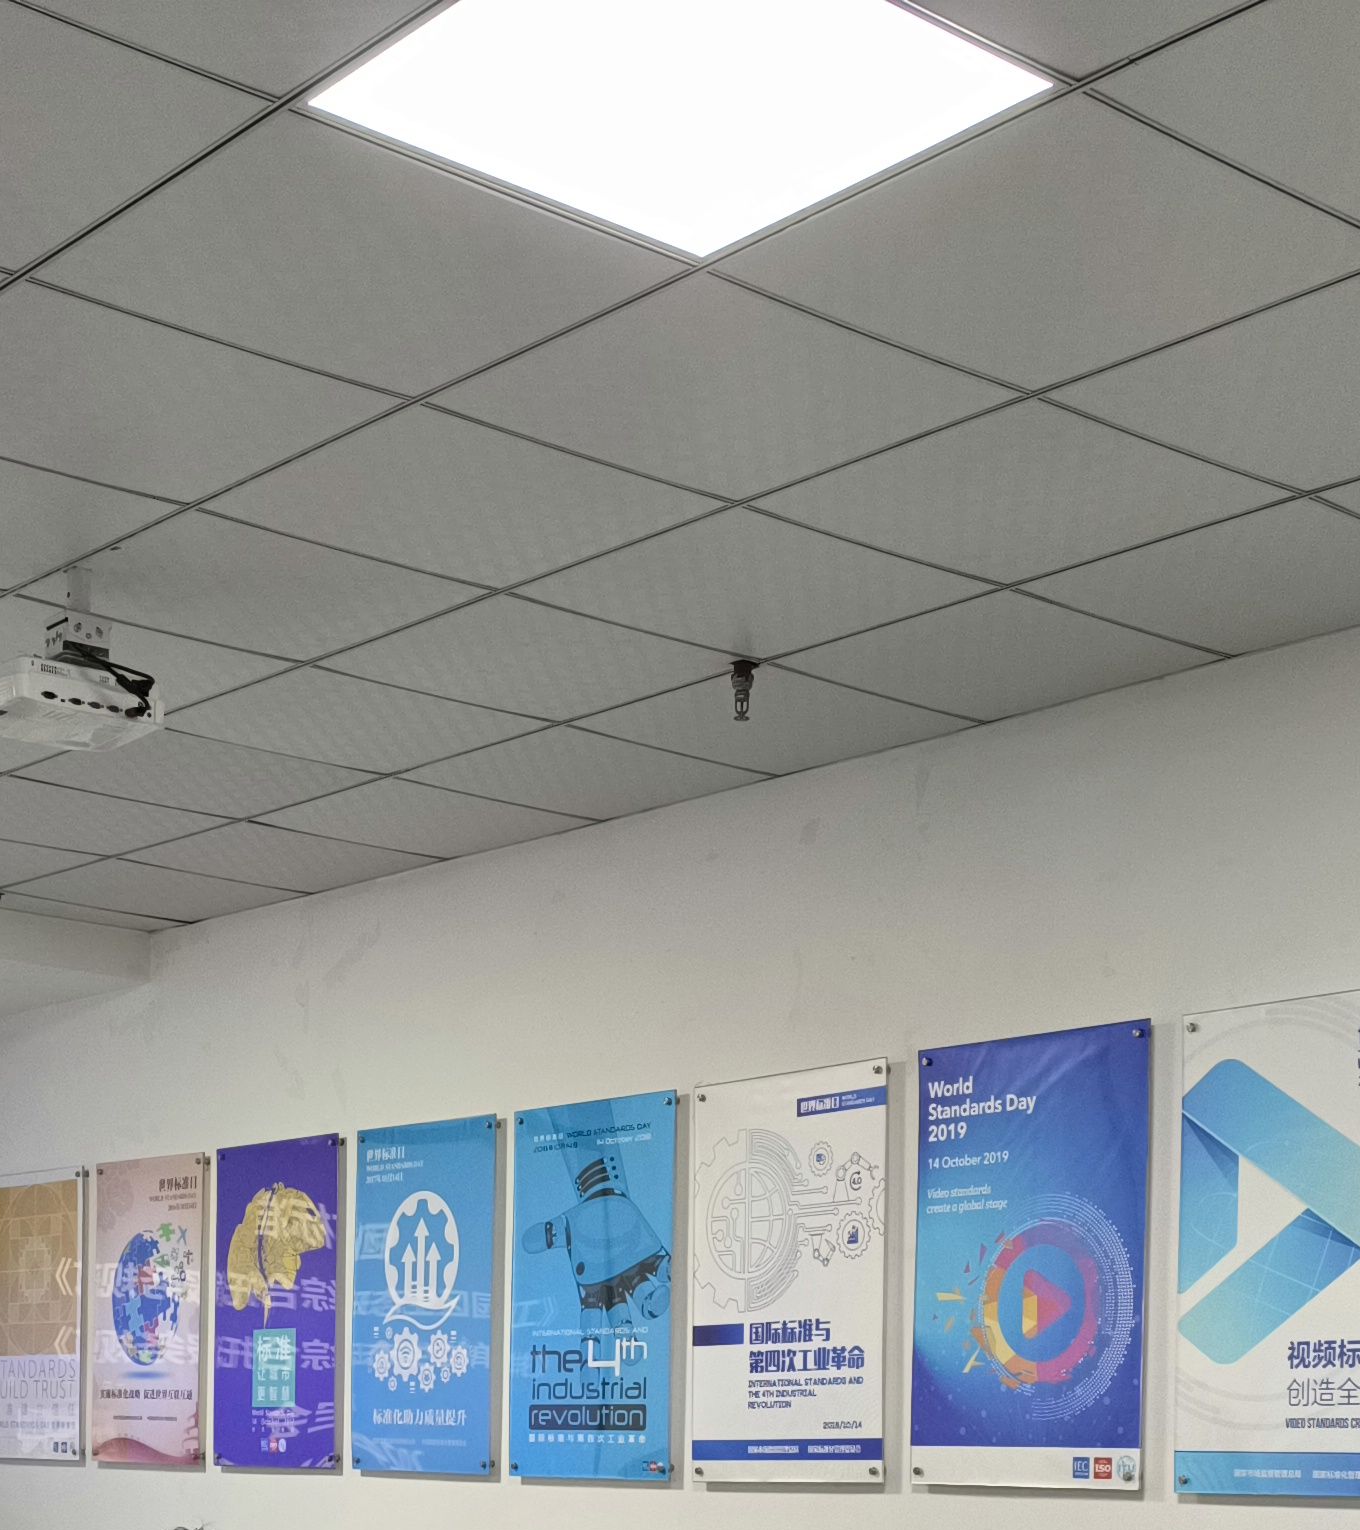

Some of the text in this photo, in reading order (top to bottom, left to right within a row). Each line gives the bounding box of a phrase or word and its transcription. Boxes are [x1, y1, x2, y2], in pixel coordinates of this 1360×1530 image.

[928, 1075, 973, 1098] World
[928, 1093, 1037, 1120] Standards Day
[928, 1122, 967, 1142] 2019
[928, 1150, 1009, 1170] 14 October 2019
[927, 1184, 992, 1199] Video standards
[926, 1202, 950, 1214] create
[958, 1198, 985, 1214] global
[985, 1199, 1008, 1211] stage
[749, 1318, 831, 1345] 国际标准与
[257, 1334, 291, 1361] 标准
[530, 1337, 648, 1377] the 4th
[749, 1345, 865, 1374] 第四次工业革命
[33, 1379, 75, 1399] TRUST
[532, 1376, 647, 1400] industrial
[748, 1376, 864, 1388] INTERNATIONAL STANDARDS AND
[748, 1388, 817, 1399] THE 4TH INDUSTRIAL
[747, 1400, 792, 1410] REVOLUTION
[531, 1405, 644, 1426] revolution
[1285, 1417, 1305, 1429] VIDEO
[1307, 1417, 1349, 1429] STANDARDS
[1074, 1460, 1089, 1472] IEC
[1095, 1463, 1111, 1473] ISO
